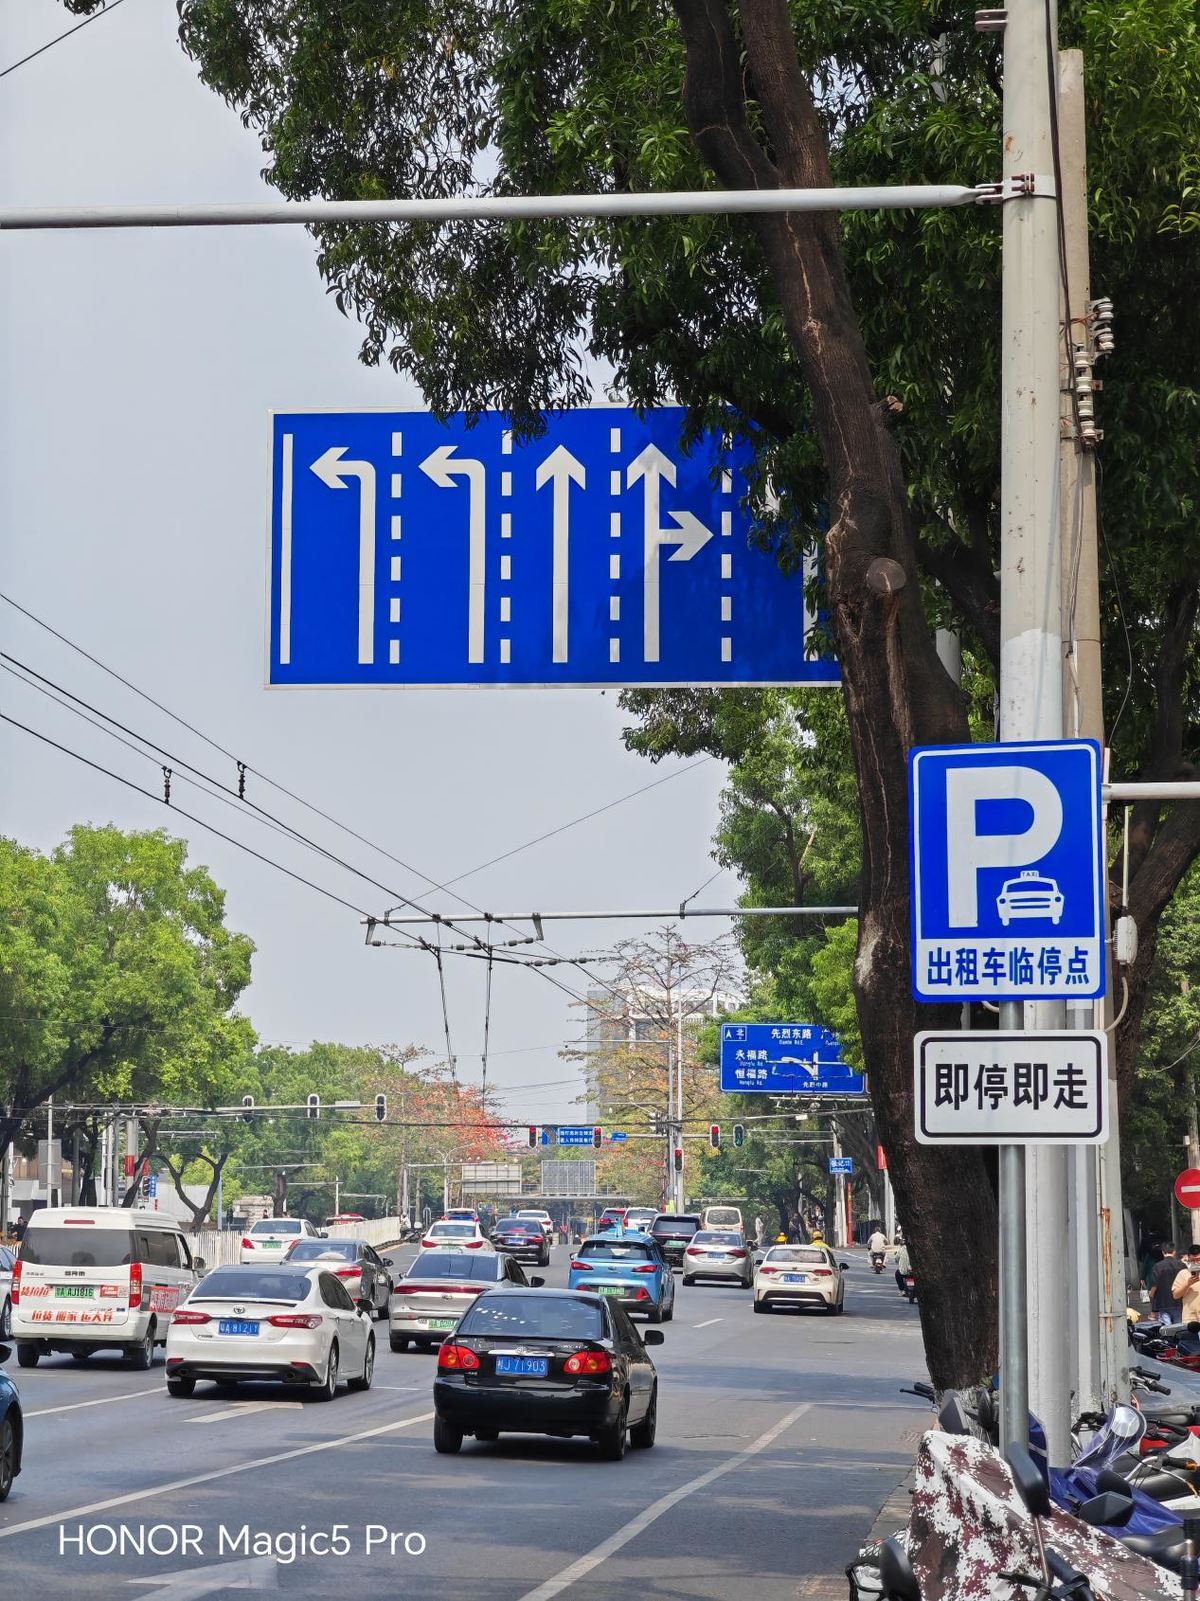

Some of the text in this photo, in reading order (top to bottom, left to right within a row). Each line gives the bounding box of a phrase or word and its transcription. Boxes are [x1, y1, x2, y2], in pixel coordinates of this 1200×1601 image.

[946, 766, 1063, 928] P
[928, 946, 1090, 986] 出租车临停点
[771, 1028, 812, 1039] 先烈东路
[735, 1049, 768, 1060] 永福路
[735, 1068, 768, 1079] 恒福路
[934, 1063, 1088, 1110] 即停即走
